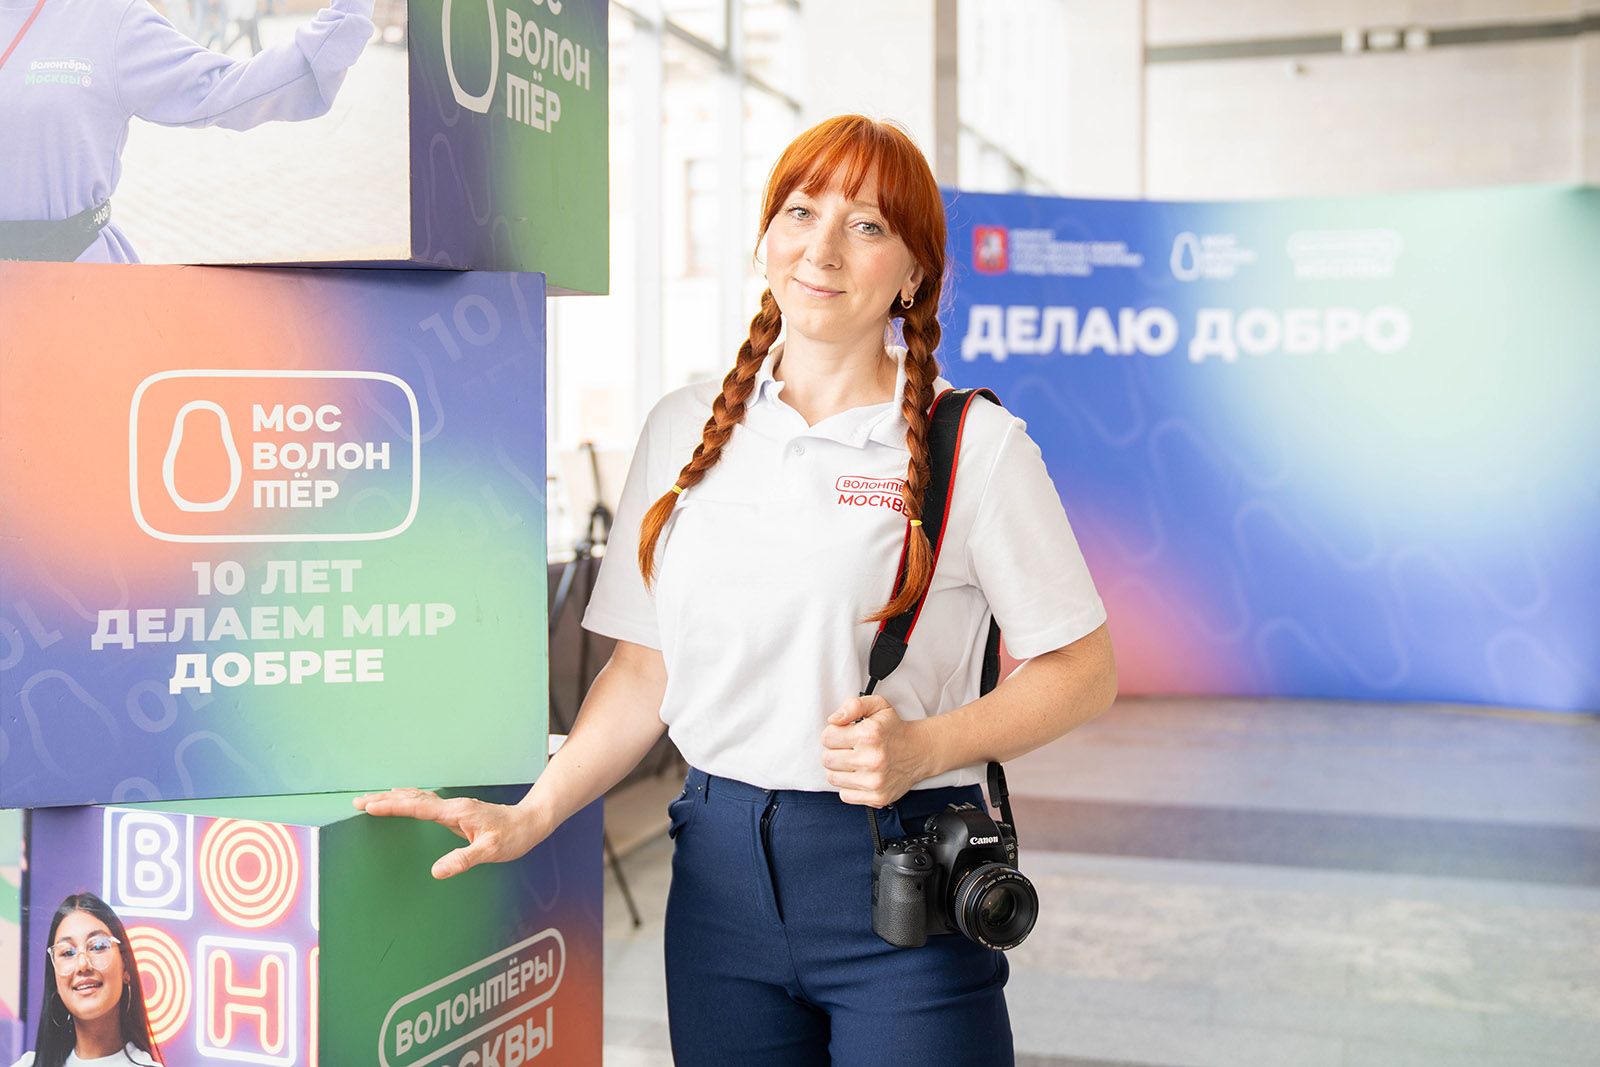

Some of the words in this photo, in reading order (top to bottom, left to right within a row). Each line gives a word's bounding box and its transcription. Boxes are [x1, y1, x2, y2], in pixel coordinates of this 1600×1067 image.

[506, 7, 590, 91] ВОЛОН
[961, 305, 1178, 362] ДЕЛАЮ
[1188, 305, 1412, 362] ДОБРО
[252, 404, 342, 432] МОС
[252, 442, 390, 470] ВОЛОН
[252, 471, 340, 508] ТЁР
[192, 561, 246, 596] 10
[260, 559, 363, 595] ЛЕТ
[91, 605, 325, 650] ДЕЛАЕМ
[342, 603, 456, 639] МИР
[169, 648, 384, 695] ДОБРЕЕ
[969, 835, 999, 846] Canon
[396, 949, 553, 1057] ВОЛОНТЁРЫ
